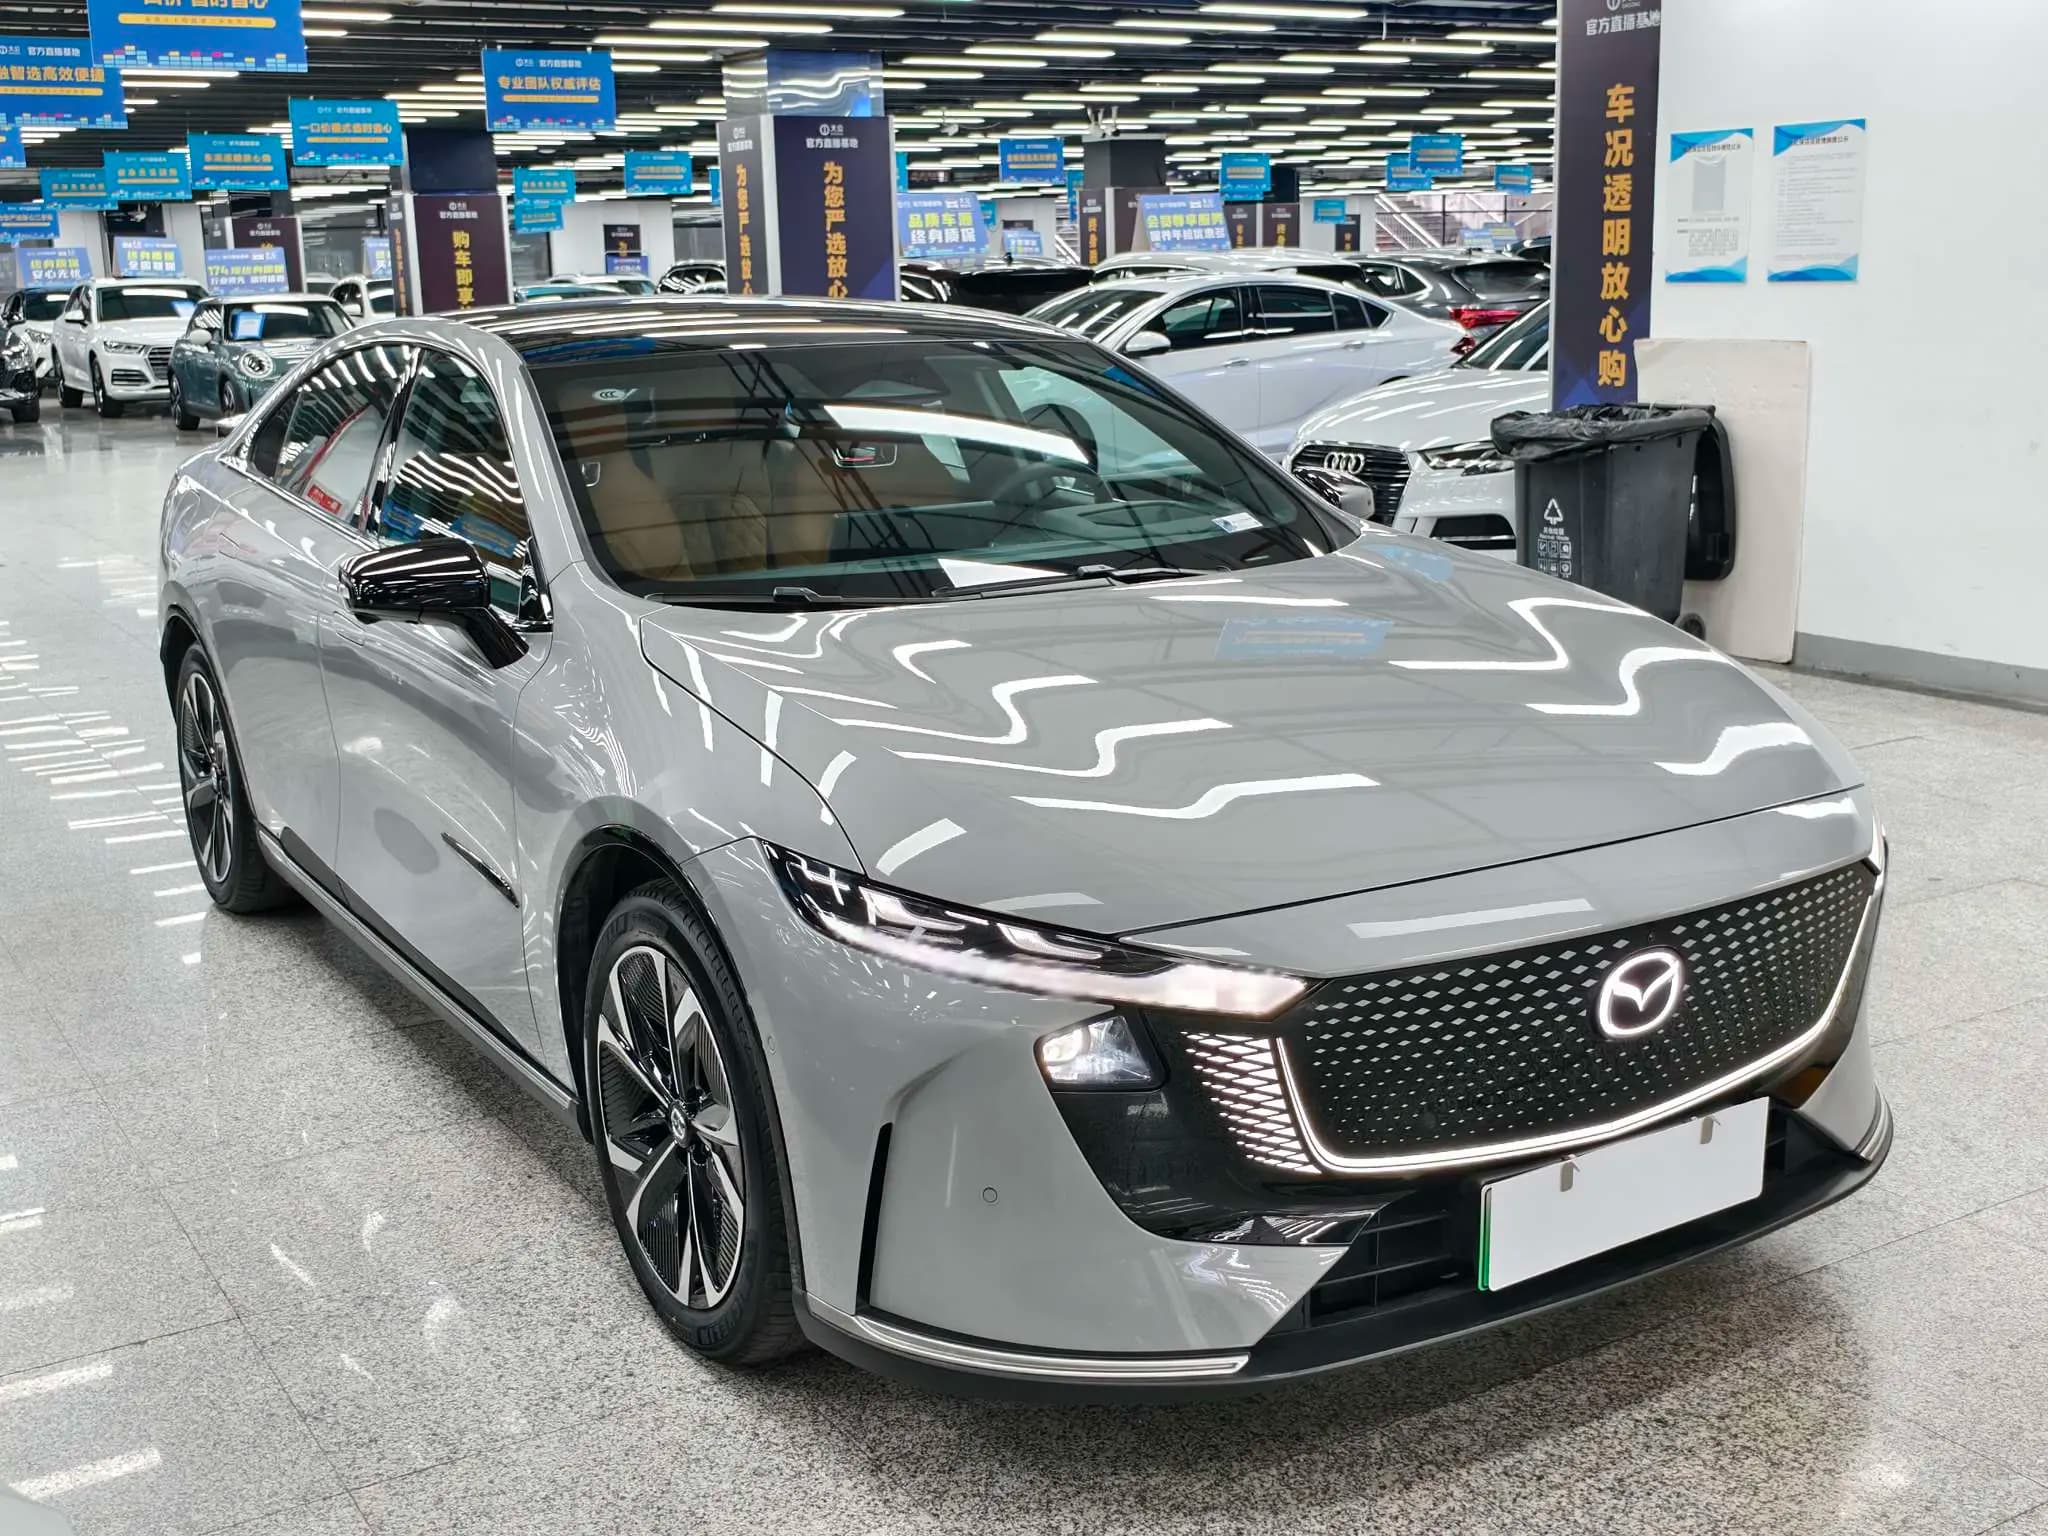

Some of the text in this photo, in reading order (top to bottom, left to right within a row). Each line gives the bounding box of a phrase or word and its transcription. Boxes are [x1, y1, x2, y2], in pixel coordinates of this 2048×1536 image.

[1597, 83, 1635, 387] 车况透明放心购
